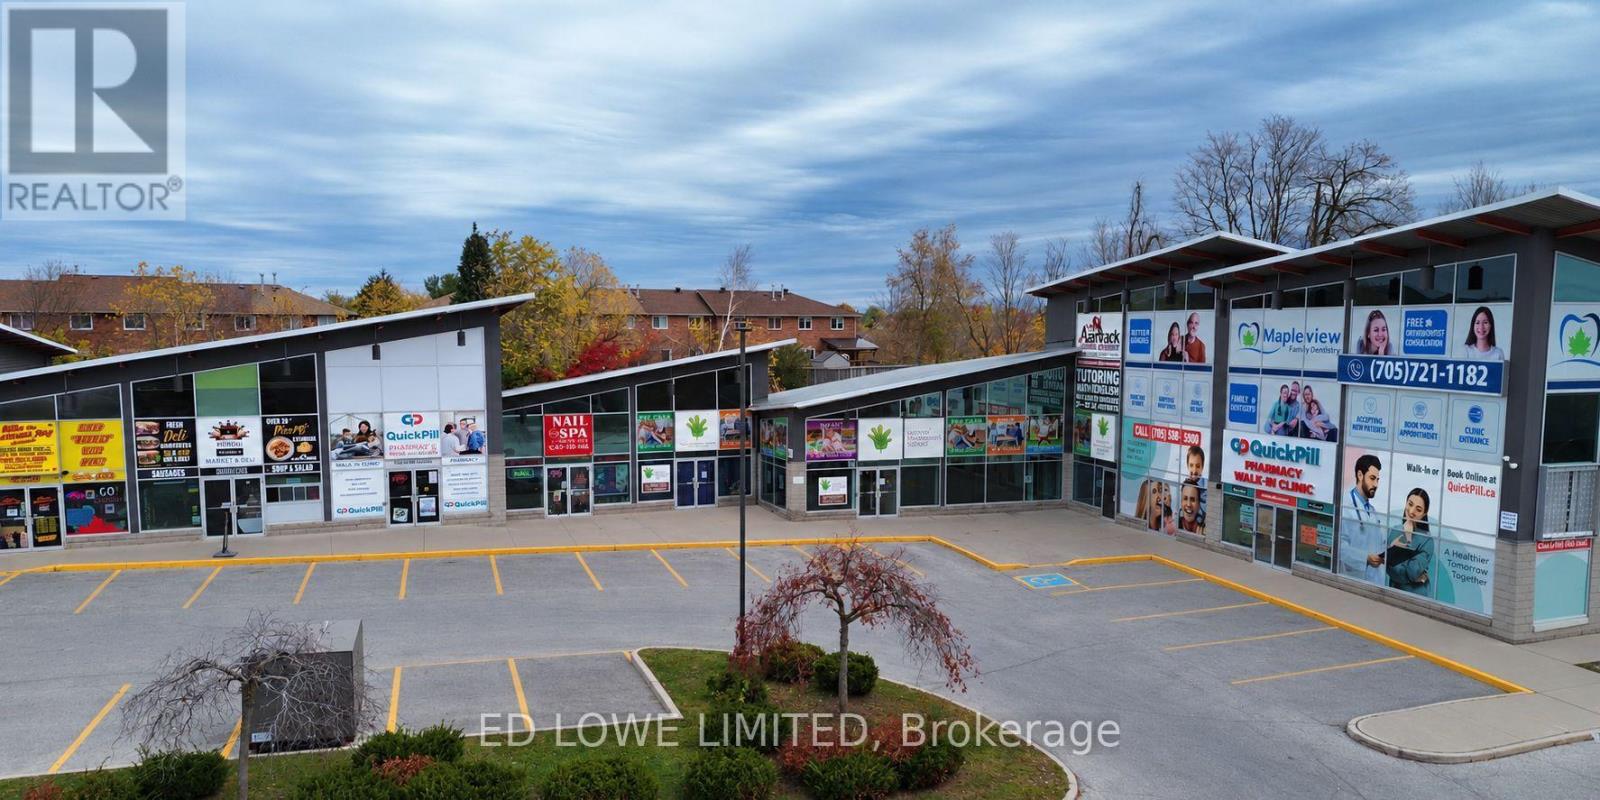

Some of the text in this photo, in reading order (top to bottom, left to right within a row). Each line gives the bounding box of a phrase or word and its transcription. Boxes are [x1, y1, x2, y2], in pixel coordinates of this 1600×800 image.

[1407, 317, 1424, 328] FREE
[1289, 345, 1341, 355] Family Dentistry
[1076, 369, 1120, 386] TUTORING
[1370, 359, 1489, 387] (705)721-1182
[552, 415, 589, 427] NAIL
[1356, 416, 1383, 424] ACCEPTING
[1404, 421, 1434, 431] BOOK YOUR
[163, 428, 189, 442] Deli
[386, 430, 440, 441] QuickPill
[559, 427, 588, 439] SPA
[1134, 425, 1149, 437] CALL
[1363, 425, 1387, 434] PATIENTS
[1399, 429, 1438, 440] APPOINTMENT
[1464, 426, 1485, 436] CLINIC
[1459, 434, 1489, 446] ENTRANCE
[1250, 439, 1321, 466] QuickPill
[1244, 460, 1303, 479] PHARMACY
[1431, 468, 1439, 476] or
[1447, 468, 1497, 484] Book Online at
[1234, 471, 1315, 495] WALK-IN CLINIC
[1447, 481, 1497, 498] QuickPill.ca
[1443, 548, 1489, 565] A Healthier
[1447, 559, 1489, 576] Tomorrow
[1451, 570, 1487, 586] Together
